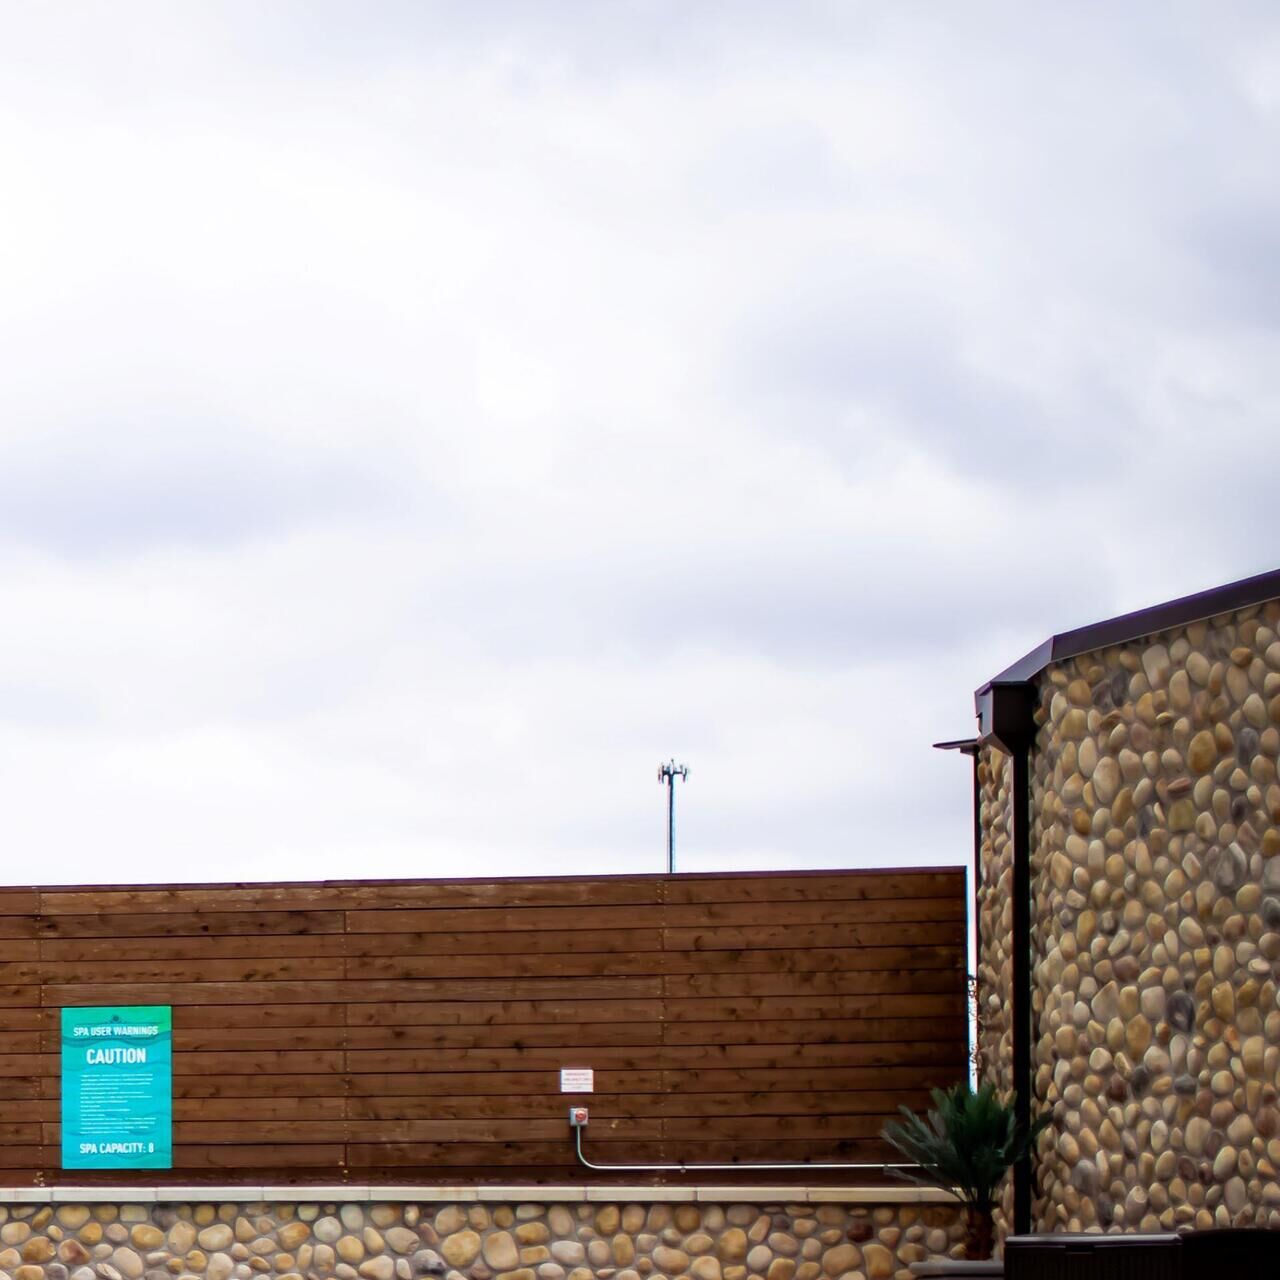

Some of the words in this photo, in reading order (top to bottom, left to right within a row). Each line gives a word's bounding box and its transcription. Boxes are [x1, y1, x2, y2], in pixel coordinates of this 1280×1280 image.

[73, 1027, 89, 1036] SPA
[90, 1026, 112, 1036] USER
[113, 1025, 158, 1036] WARNINGS
[86, 1048, 146, 1065] CAUTION
[80, 1143, 97, 1154] SPA
[99, 1142, 146, 1153] CAPACITY:
